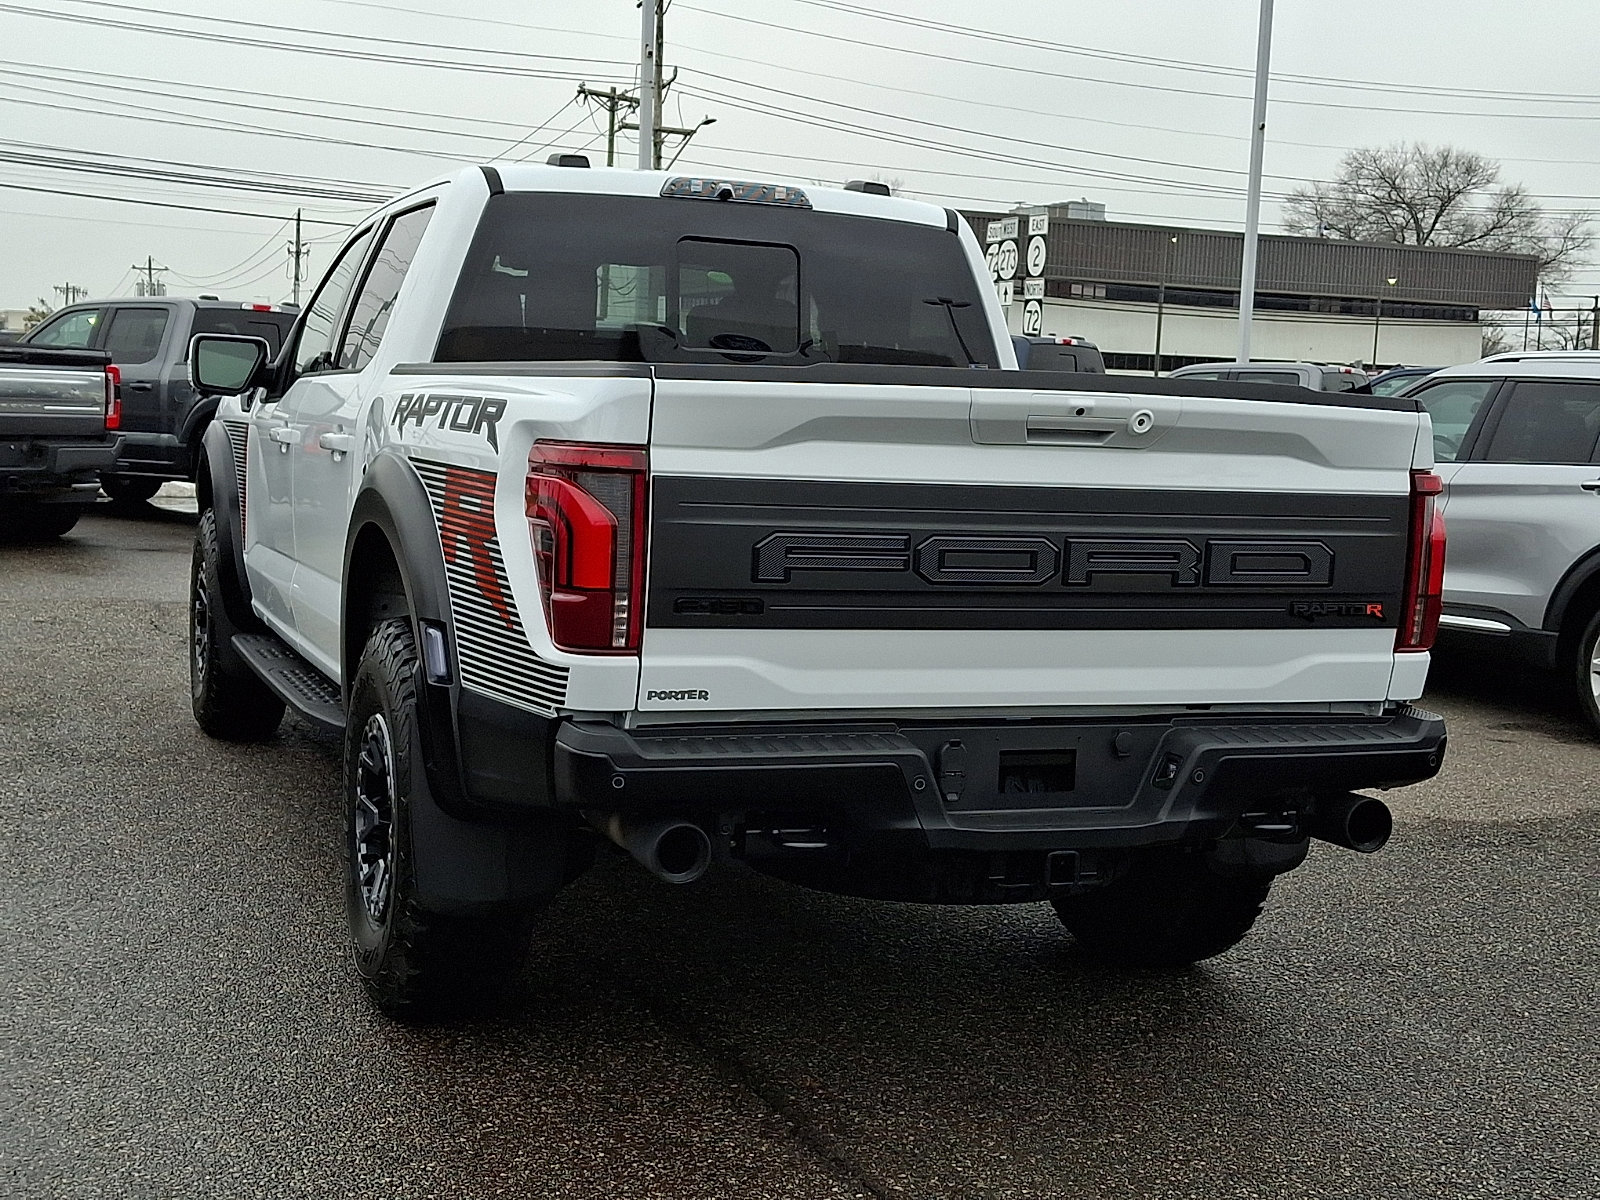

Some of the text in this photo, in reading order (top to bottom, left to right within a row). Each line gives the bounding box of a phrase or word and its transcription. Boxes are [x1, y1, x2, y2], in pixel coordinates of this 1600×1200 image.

[1032, 218, 1045, 231] EAST
[1000, 248, 1016, 271] 273
[1033, 245, 1041, 267] 2
[1026, 309, 1039, 331] 72
[390, 393, 508, 455] RAPTOR
[752, 530, 1335, 588] FORD
[1290, 601, 1385, 620] RAPTOR
[647, 690, 709, 701] PORTER
